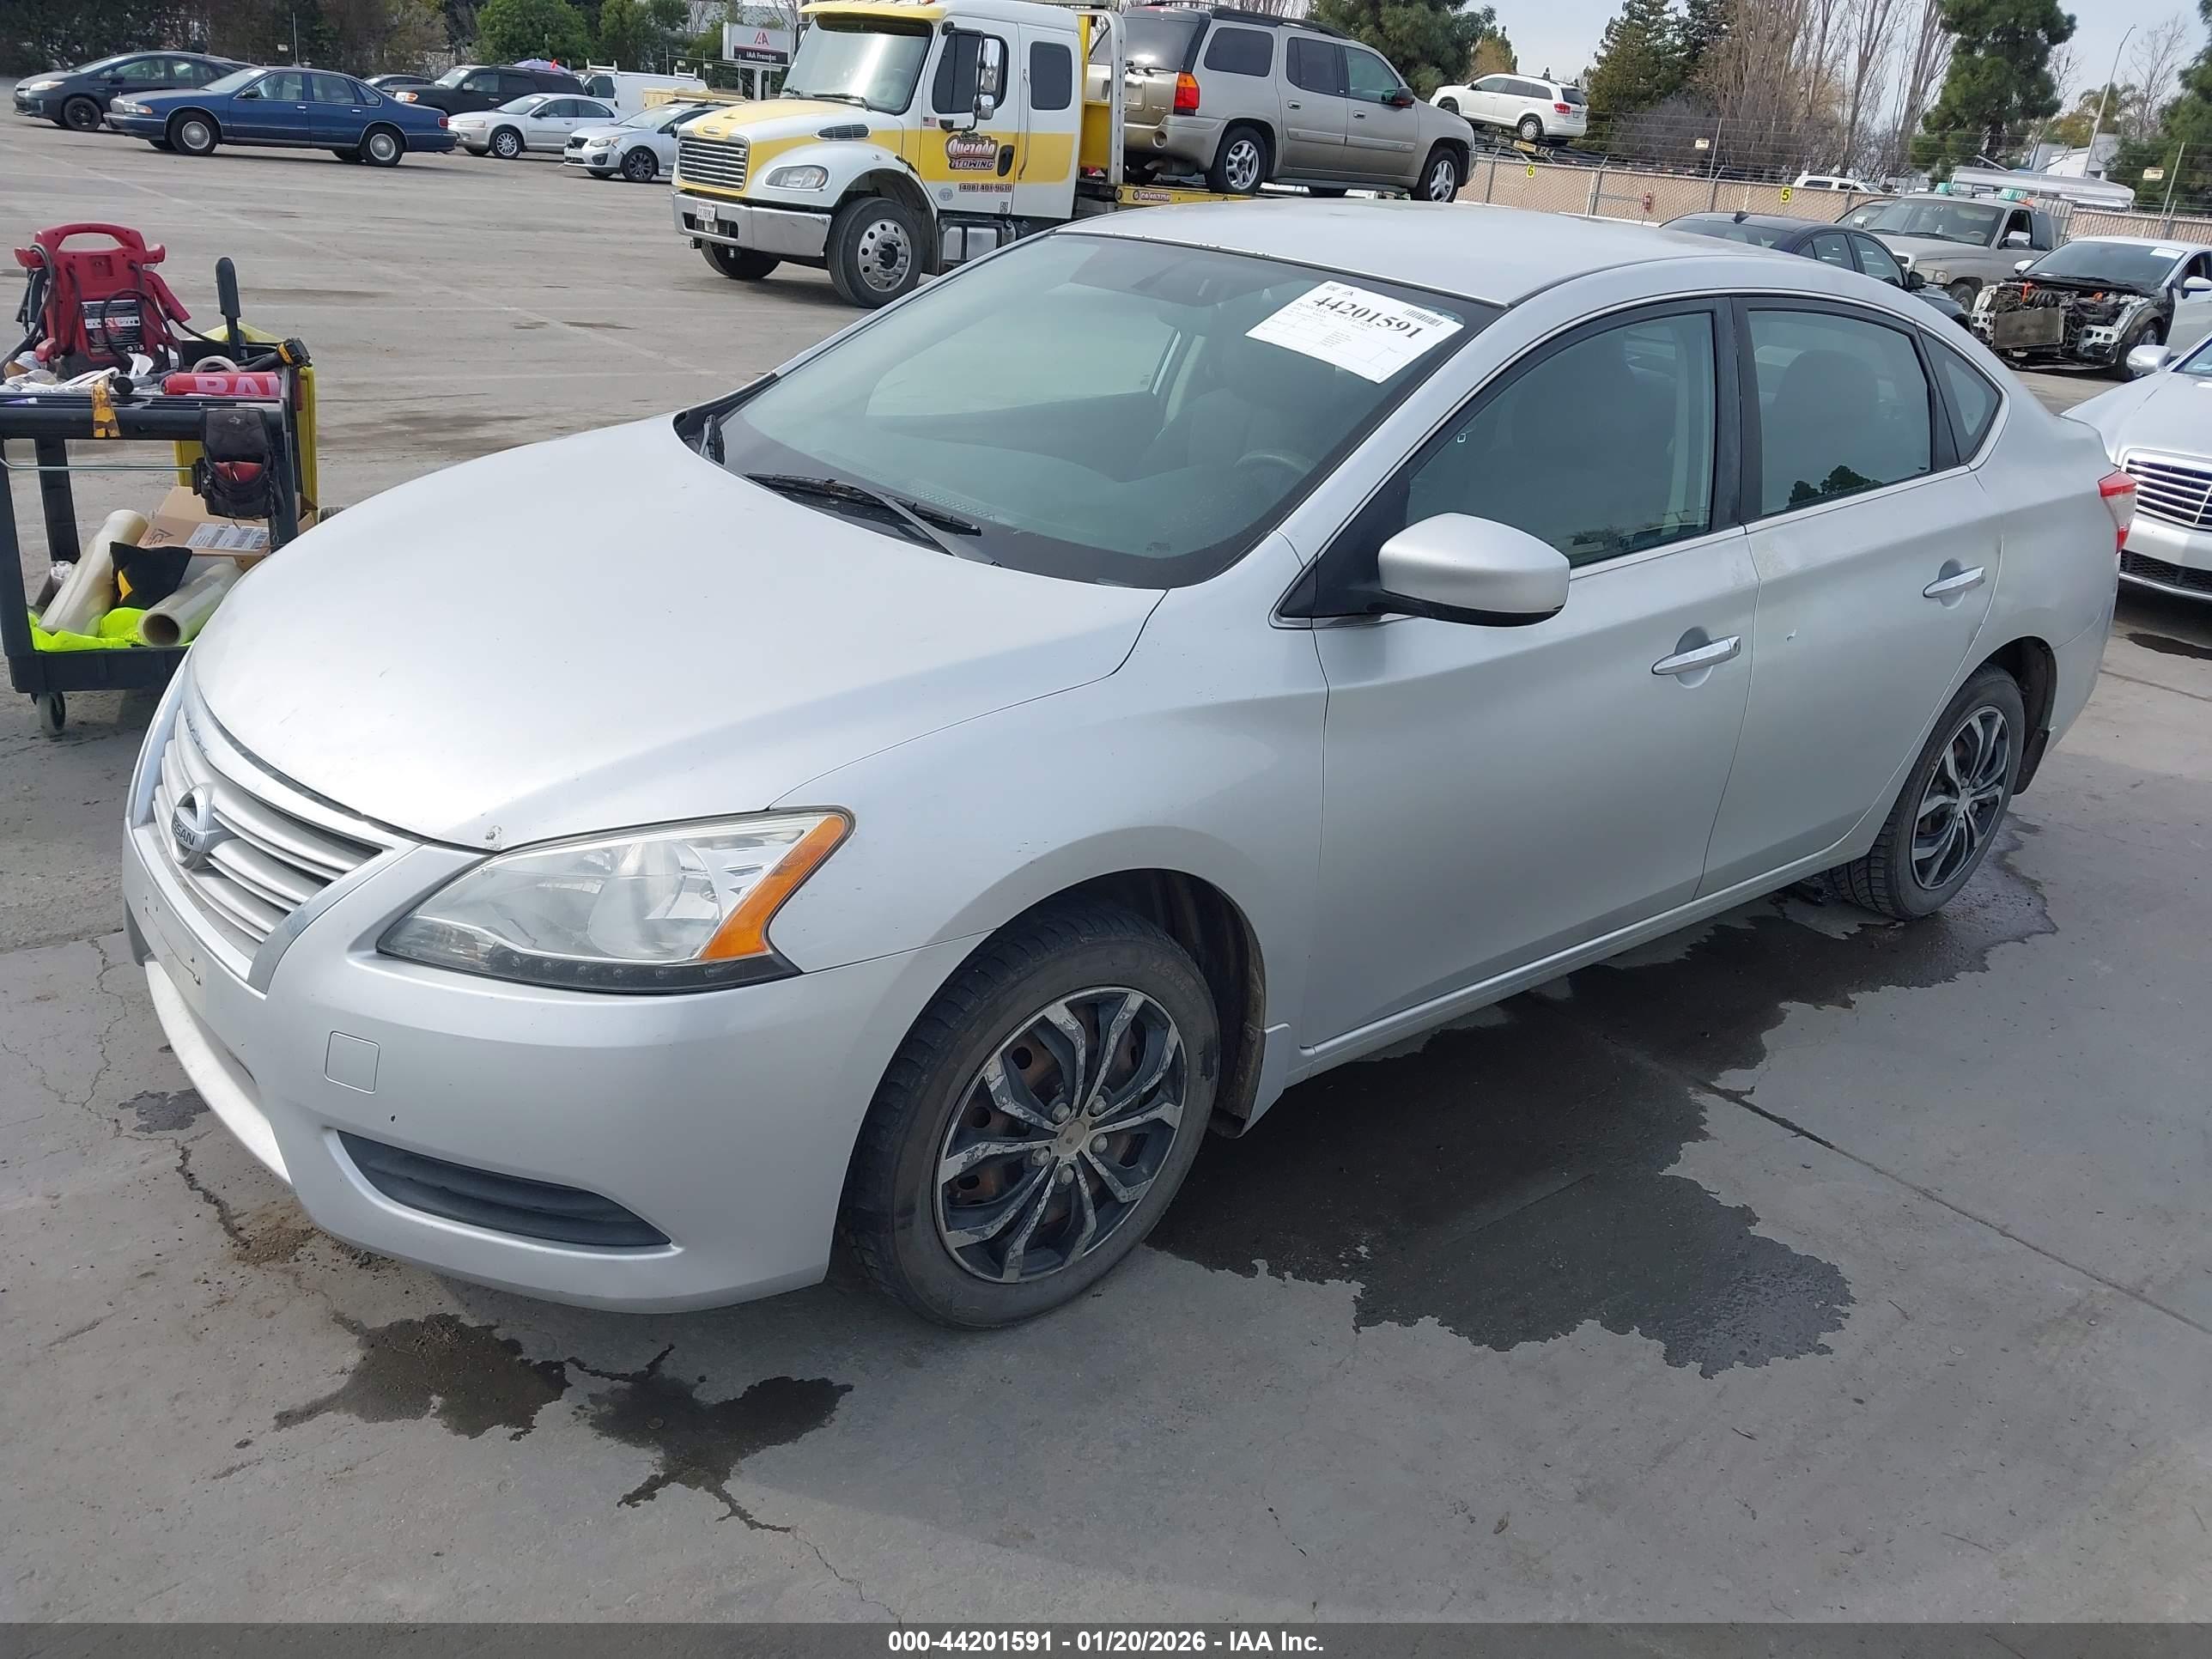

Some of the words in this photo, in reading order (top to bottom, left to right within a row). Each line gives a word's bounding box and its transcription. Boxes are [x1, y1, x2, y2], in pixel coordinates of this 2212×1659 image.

[955, 160, 994, 169] TOWING
[1528, 166, 1534, 176] 6
[1782, 189, 1790, 201] 5
[1313, 296, 1424, 338] 44201591
